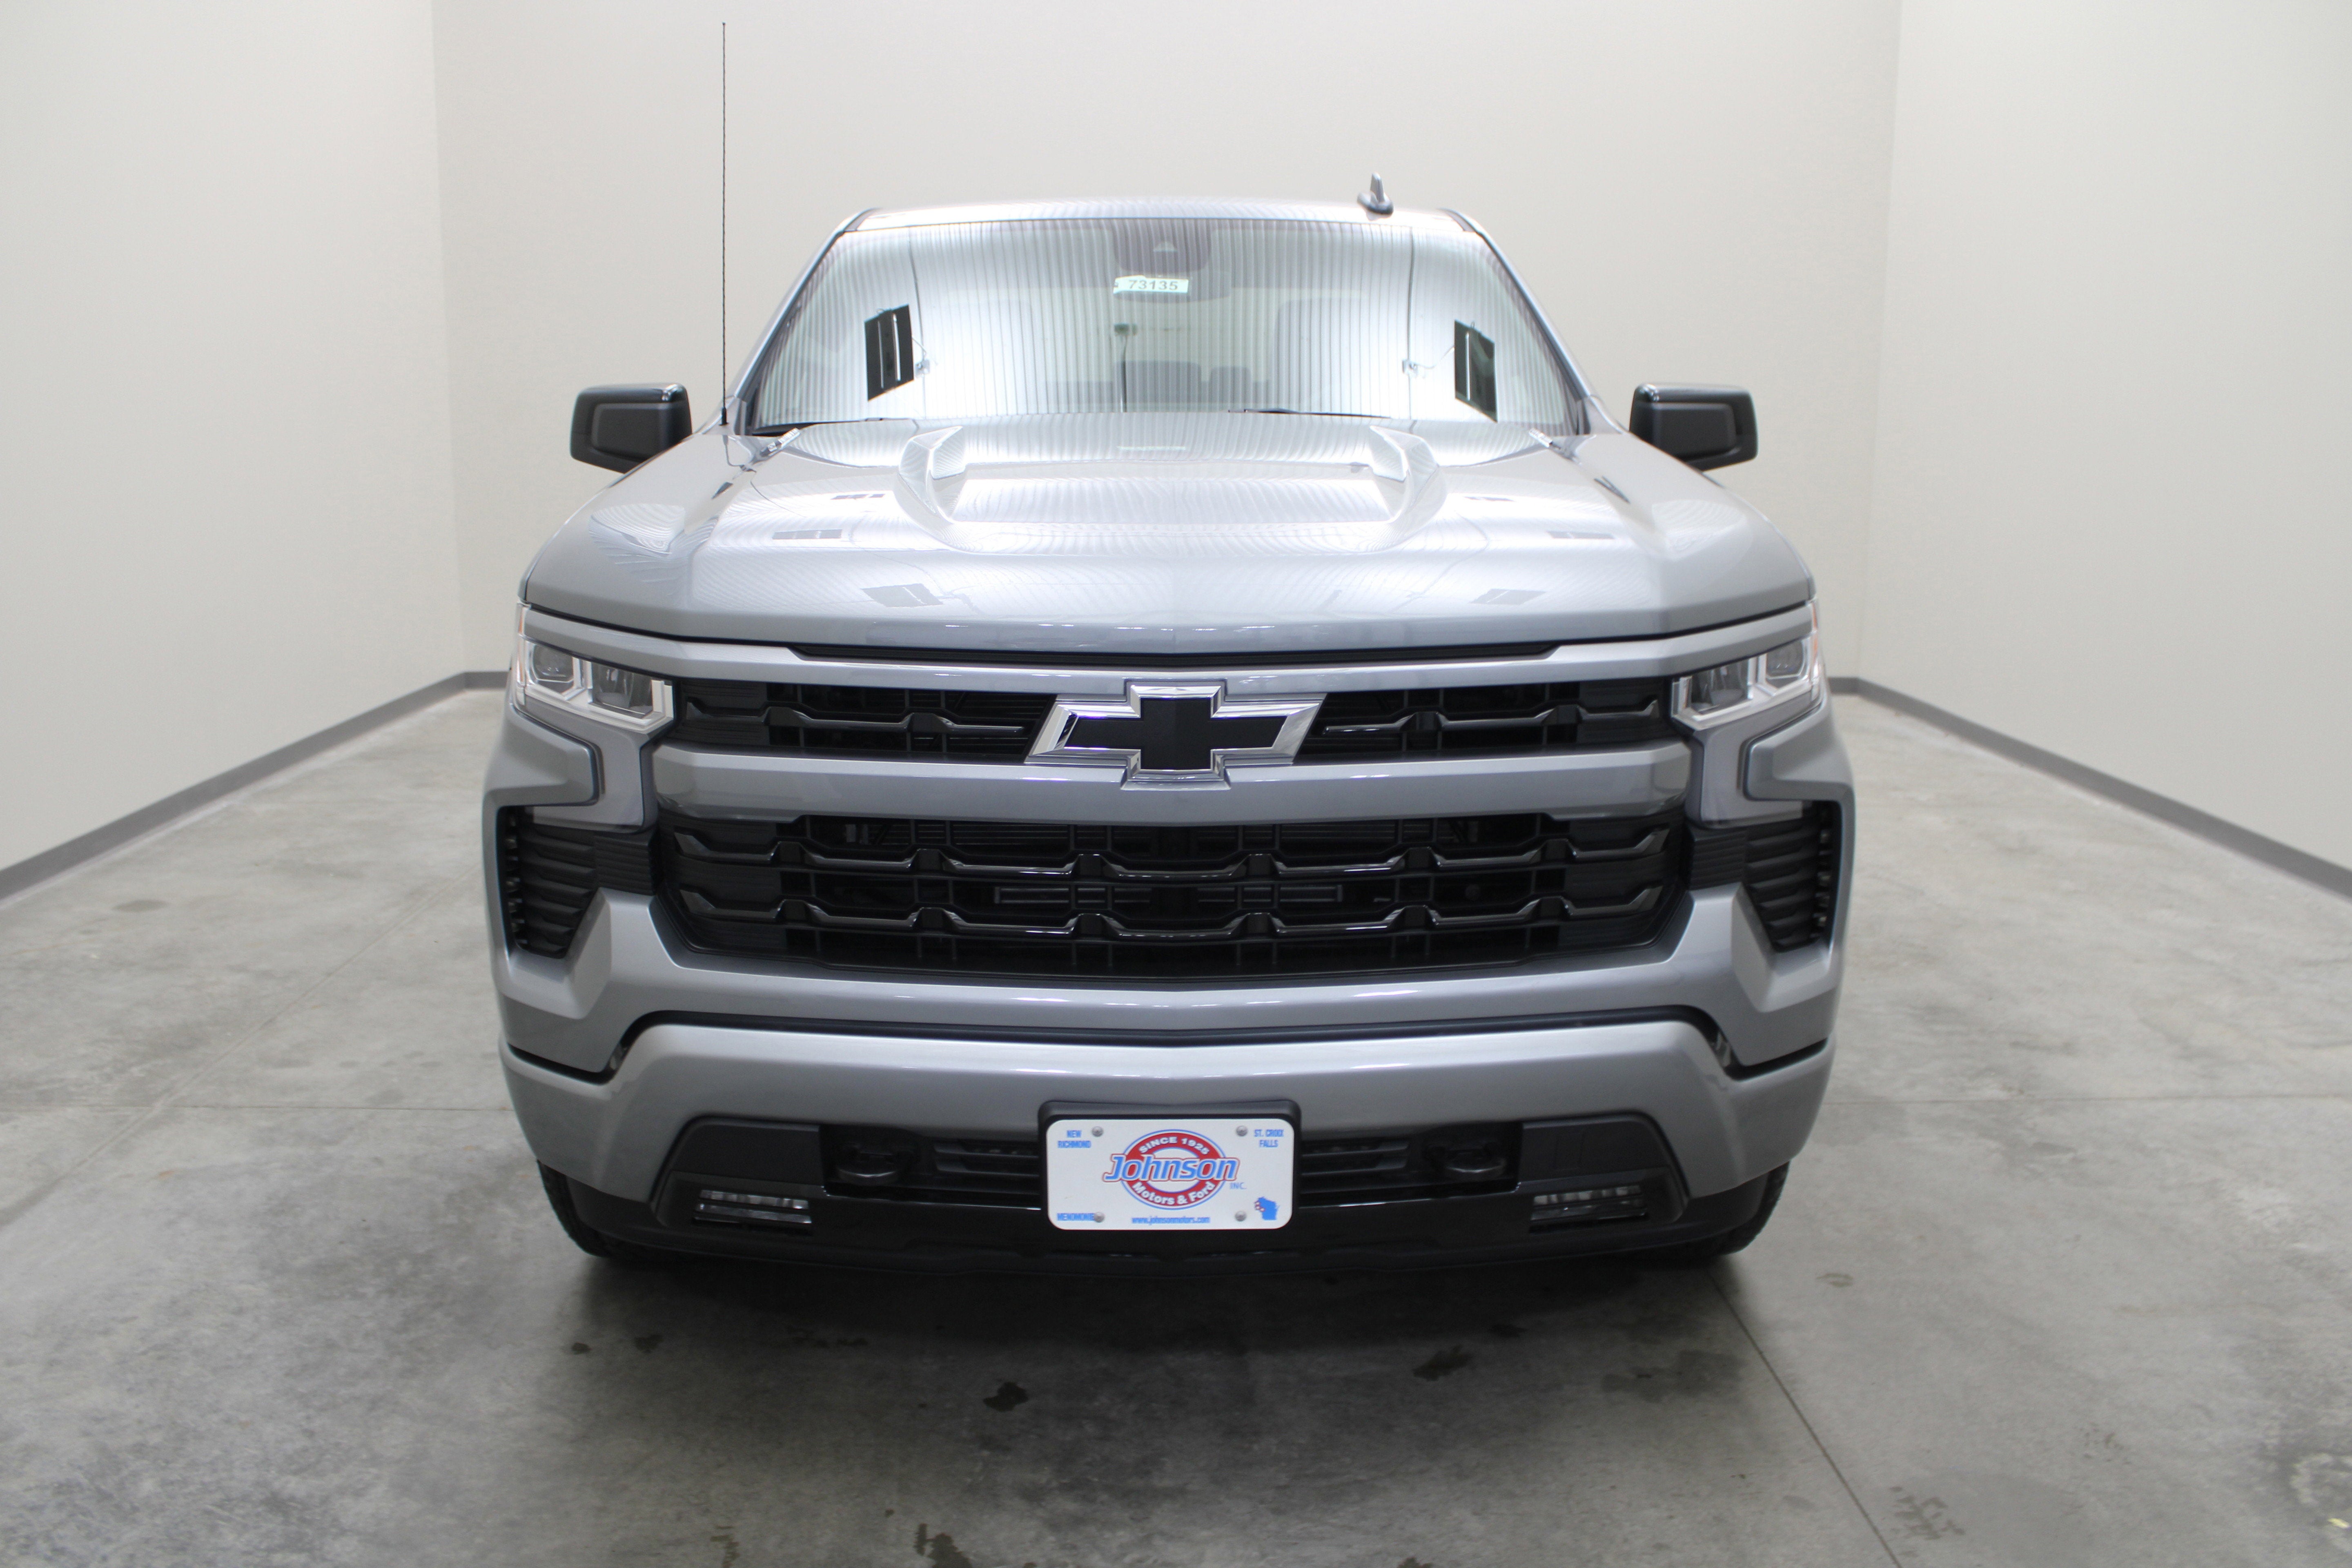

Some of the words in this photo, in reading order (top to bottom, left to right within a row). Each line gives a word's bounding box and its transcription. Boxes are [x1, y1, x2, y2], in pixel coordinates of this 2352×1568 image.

[1129, 280, 1178, 290] 73135
[1138, 1136, 1177, 1154] SINCE
[1181, 1138, 1209, 1155] 1925
[1105, 1156, 1238, 1180] Johnson
[1132, 1181, 1175, 1205] Motors
[1177, 1195, 1188, 1205] &
[1188, 1181, 1216, 1202] Ford
